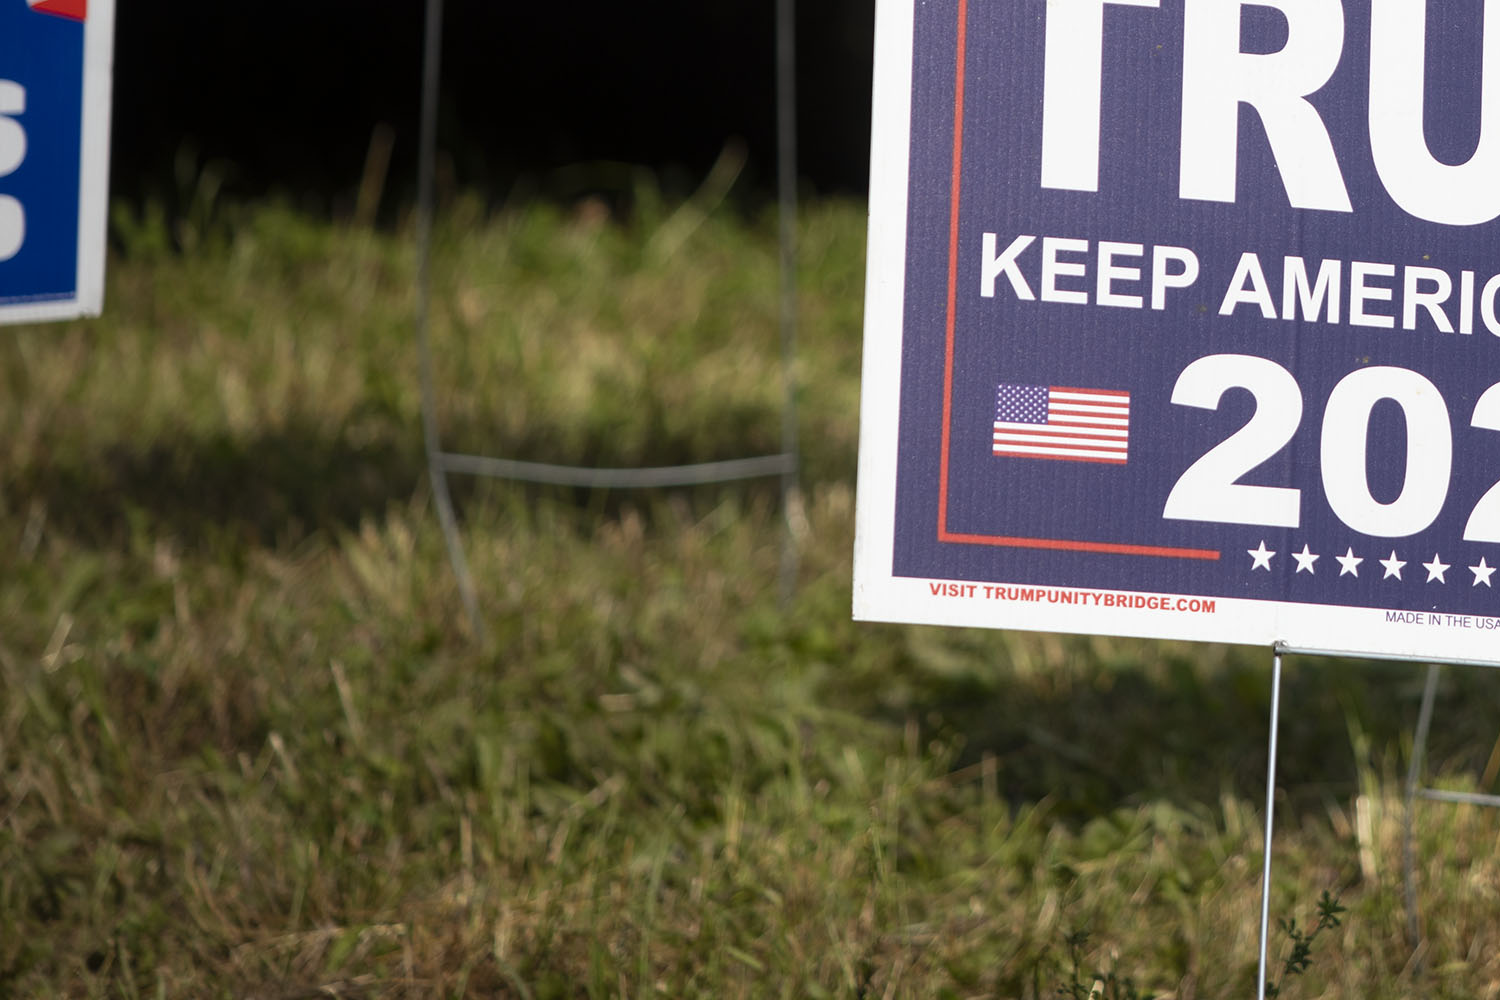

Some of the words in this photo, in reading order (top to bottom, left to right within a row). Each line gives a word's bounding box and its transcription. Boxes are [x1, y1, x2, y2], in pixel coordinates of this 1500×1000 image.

[980, 232, 1200, 311] KEEP
[929, 582, 977, 598] VISIT
[983, 586, 1216, 613] TRUMPUNITYBRIDGE.COM
[1385, 610, 1424, 625] MADE
[1428, 613, 1441, 626] IN
[1445, 615, 1472, 628] THE
